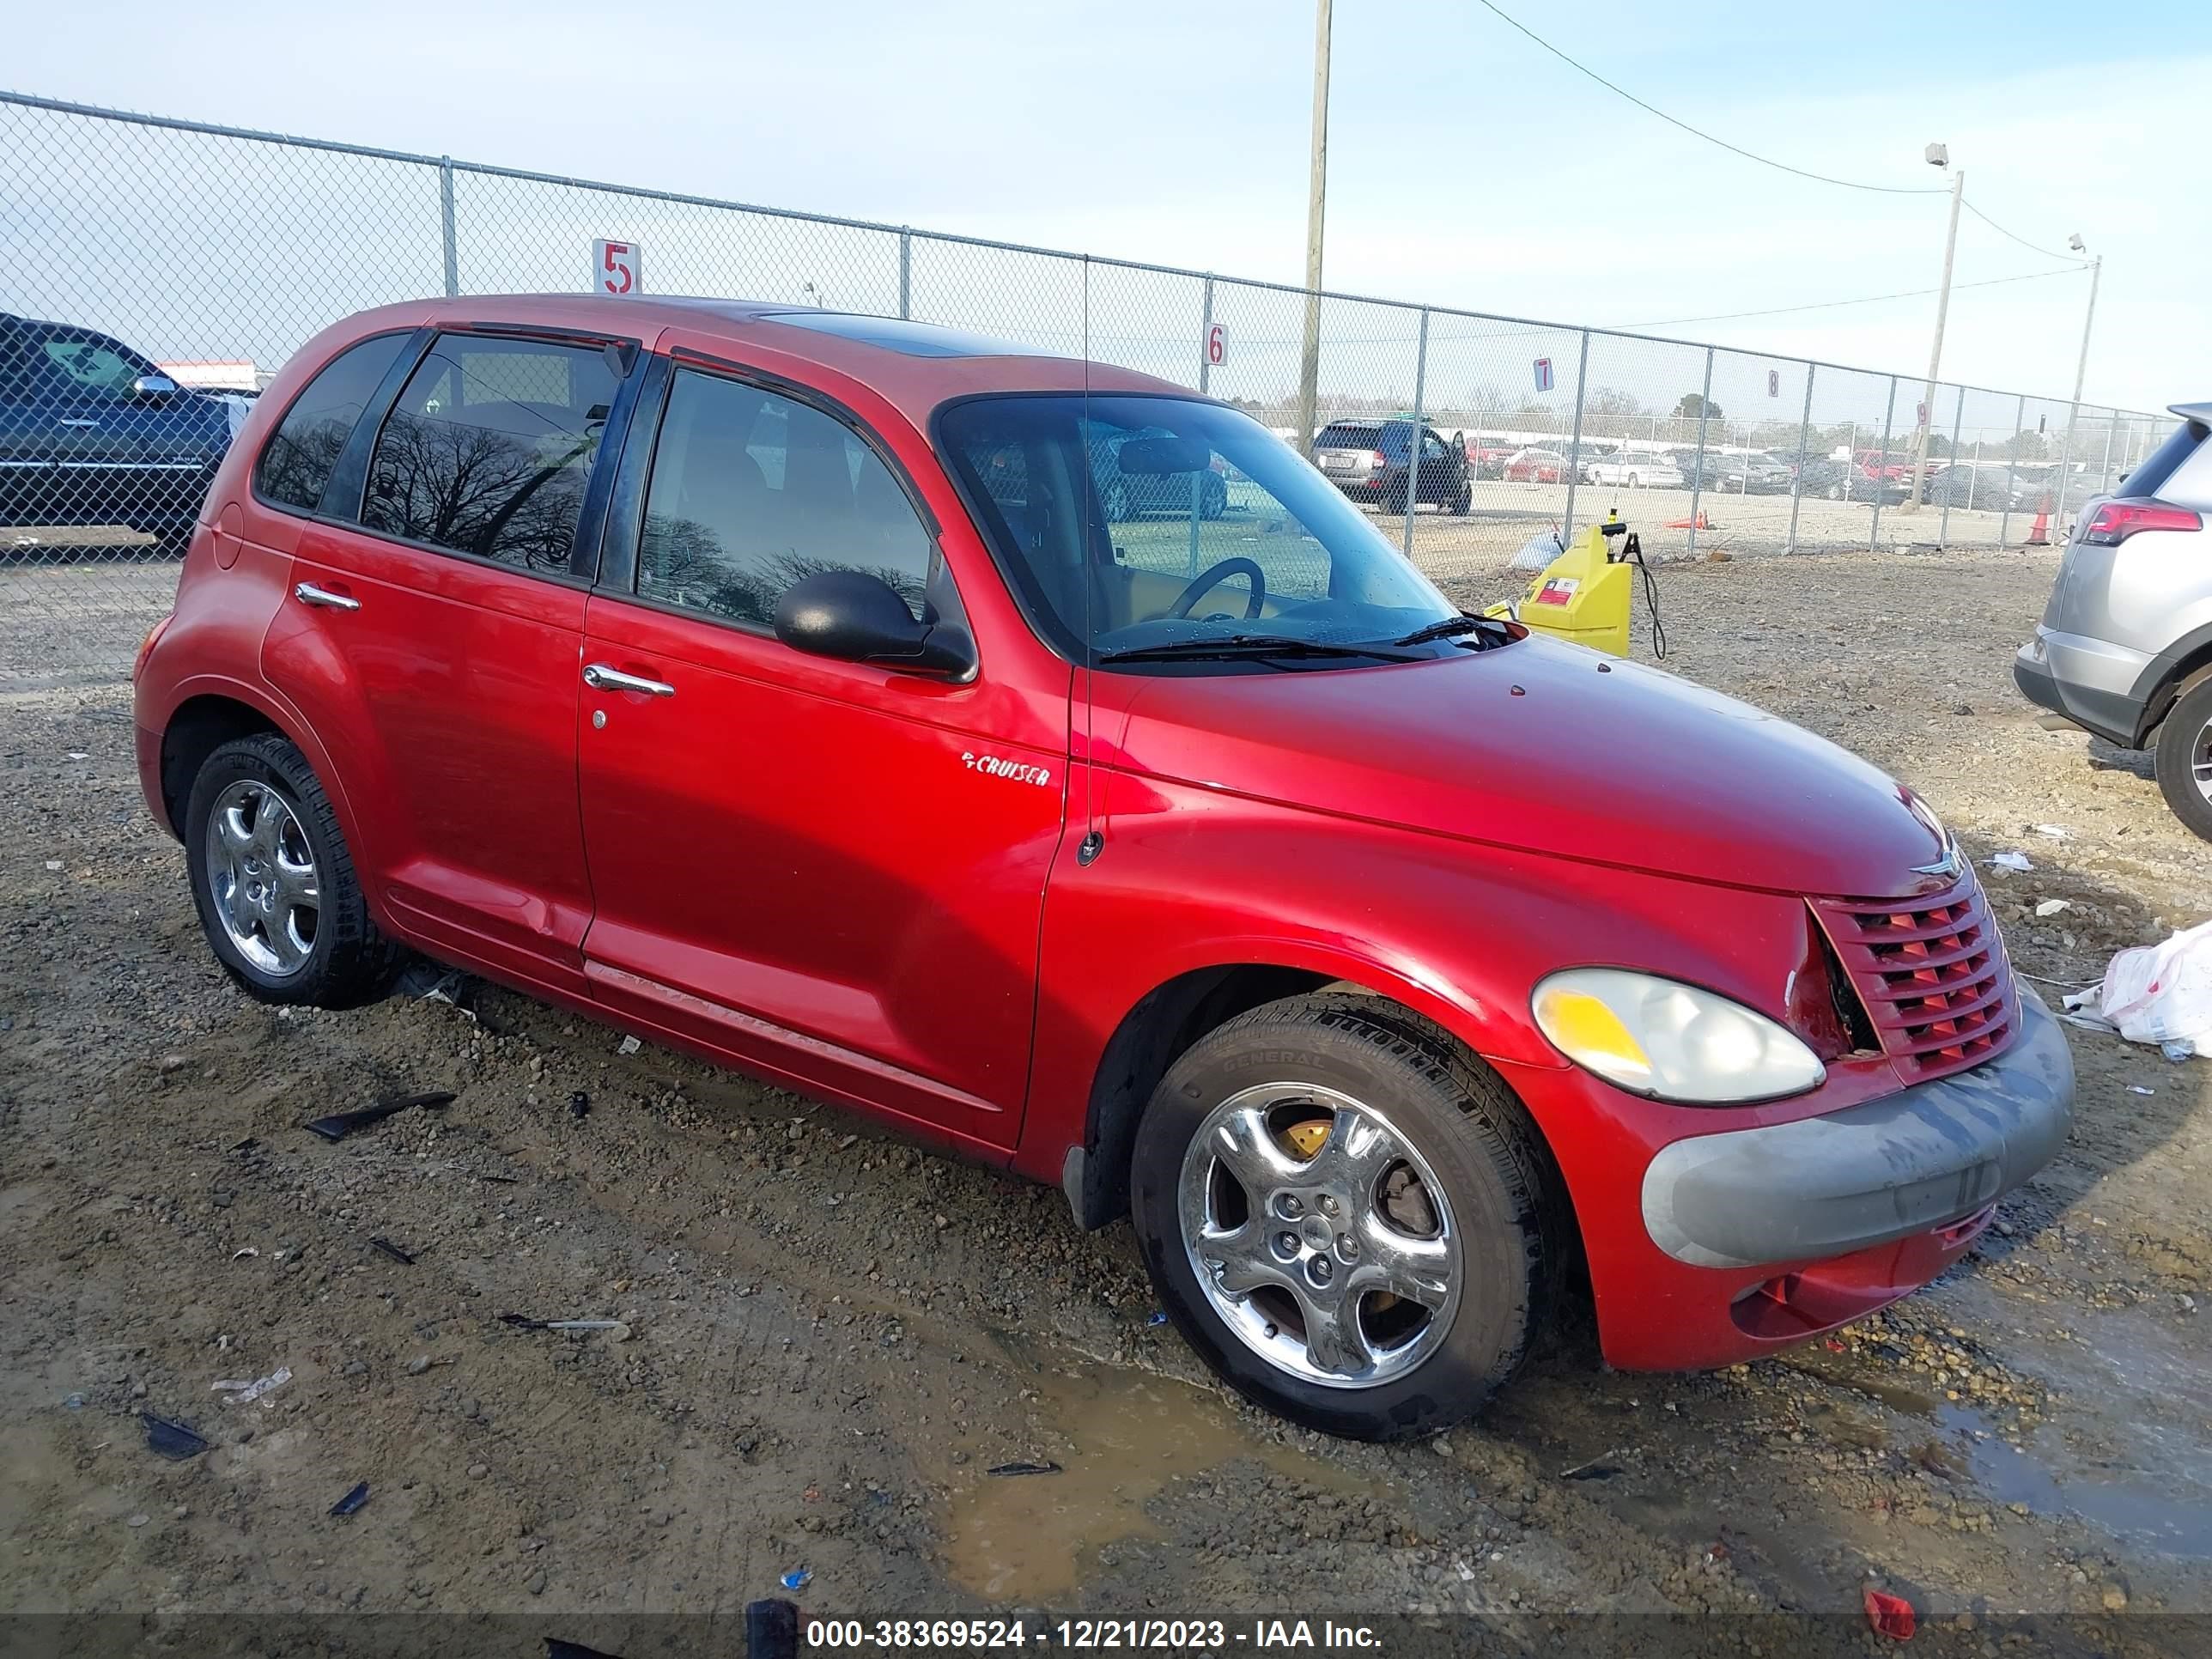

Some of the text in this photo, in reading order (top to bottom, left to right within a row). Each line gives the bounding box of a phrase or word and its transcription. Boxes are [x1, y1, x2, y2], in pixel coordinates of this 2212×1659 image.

[605, 243, 632, 294] 5
[1209, 326, 1223, 363] 6
[1538, 360, 1548, 386] 7
[1771, 373, 1777, 395] 8
[961, 751, 1051, 787] PT CRUISER
[1223, 1050, 1326, 1073] GENERAL
